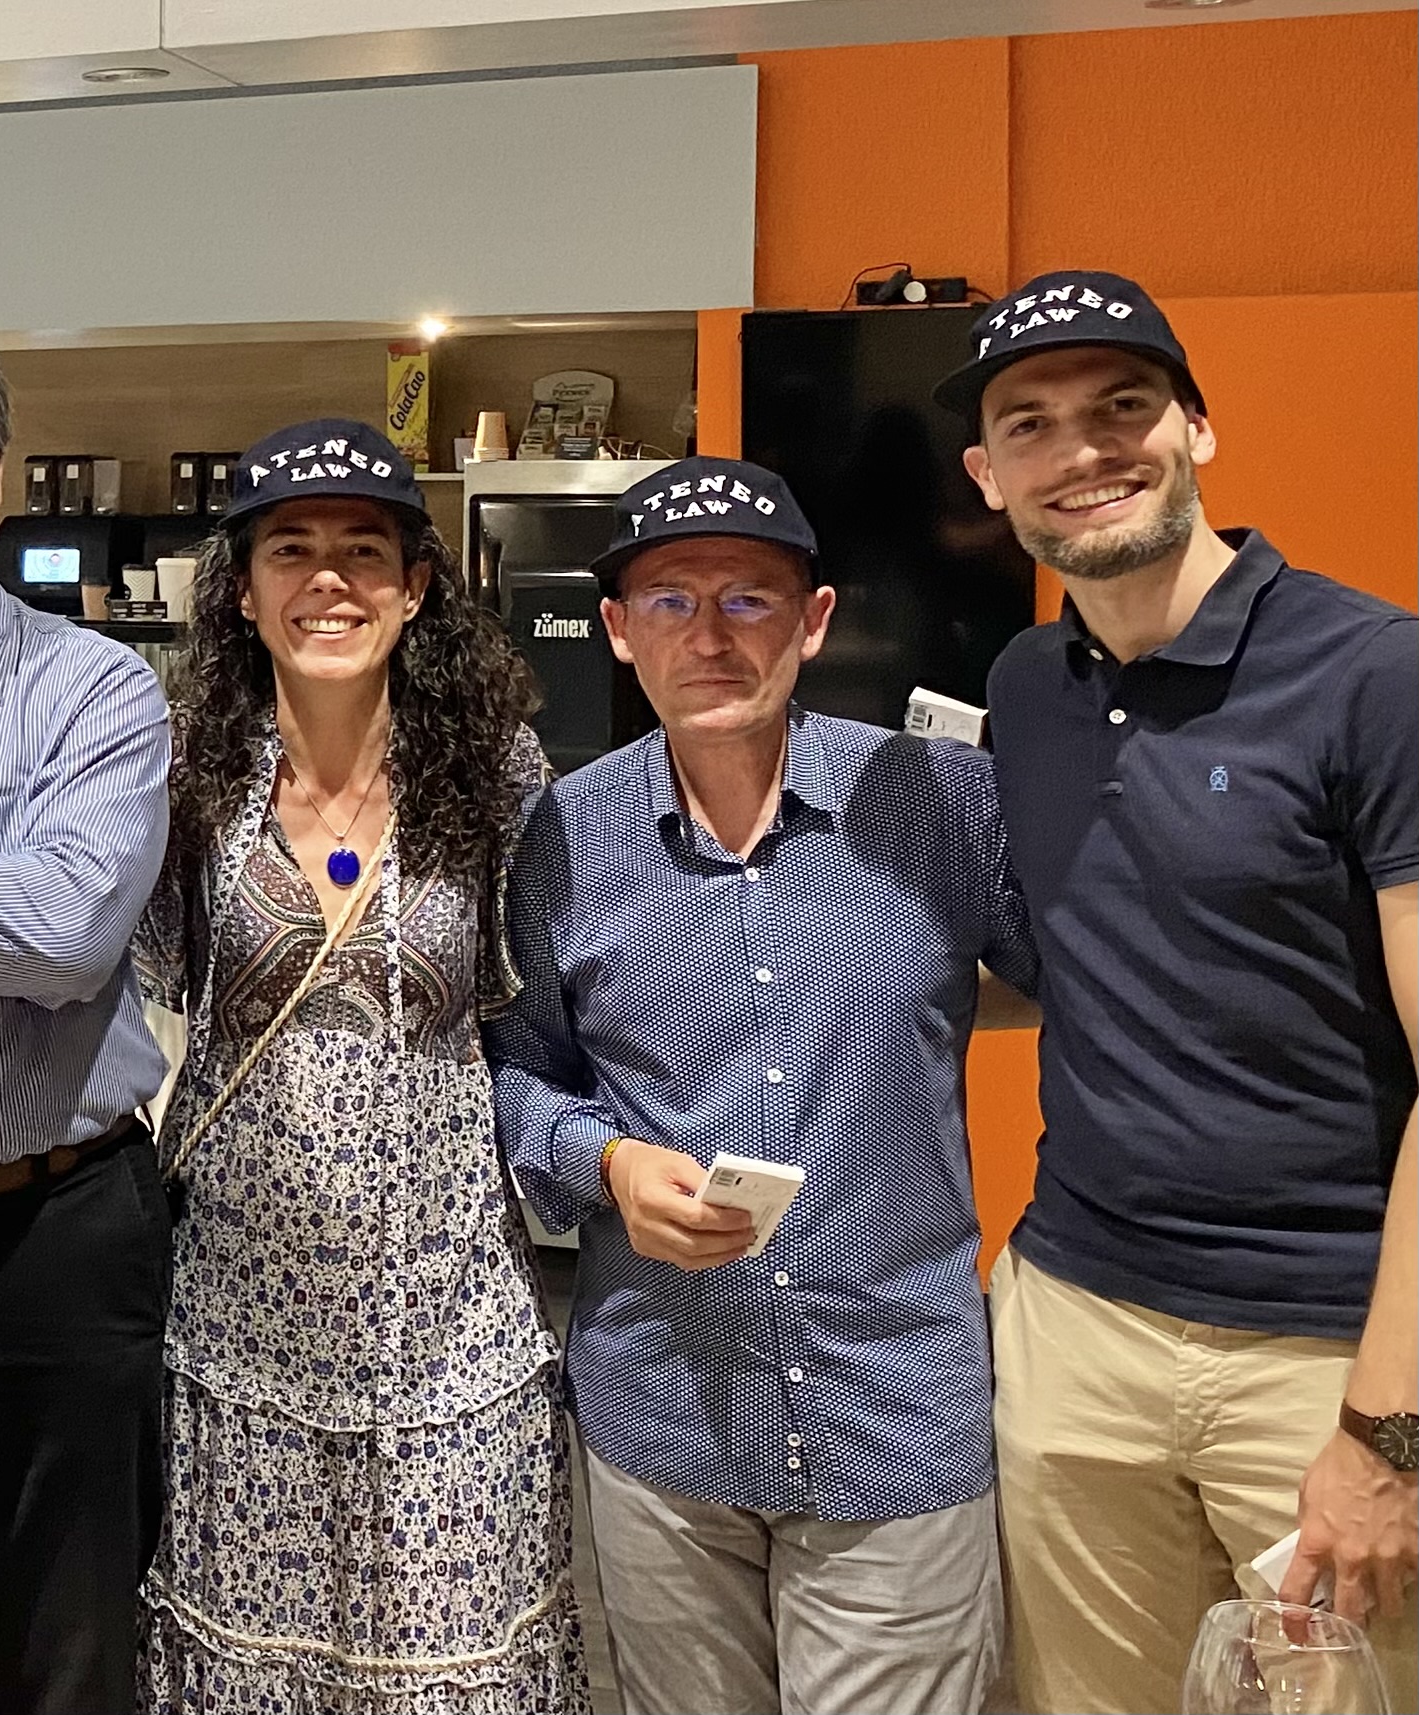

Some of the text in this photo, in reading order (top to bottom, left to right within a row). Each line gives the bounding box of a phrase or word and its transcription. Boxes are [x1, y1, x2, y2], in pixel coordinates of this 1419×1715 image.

[1010, 308, 1080, 339] LAW
[390, 371, 426, 430] ColaCao
[250, 438, 392, 487] ATENEO
[290, 463, 351, 482] LAW
[665, 500, 732, 522] LAW
